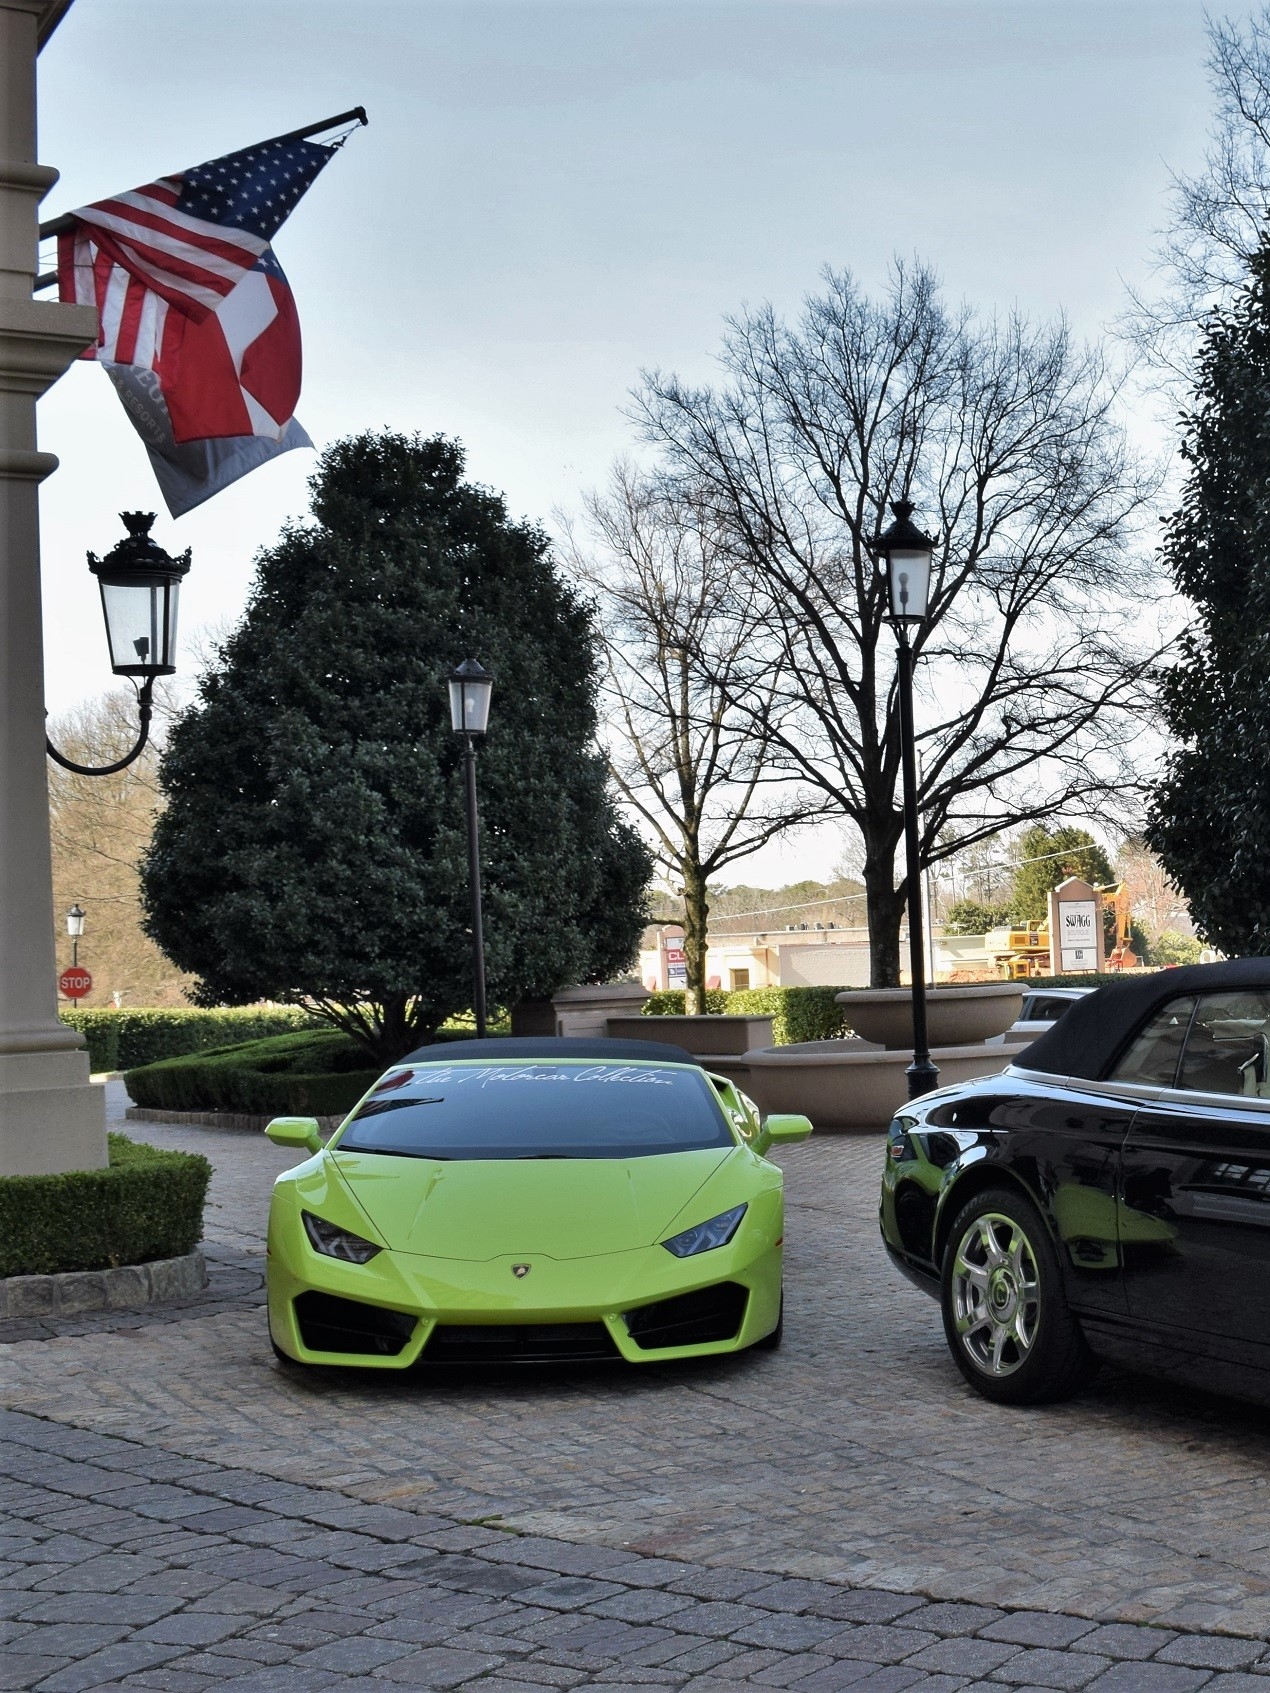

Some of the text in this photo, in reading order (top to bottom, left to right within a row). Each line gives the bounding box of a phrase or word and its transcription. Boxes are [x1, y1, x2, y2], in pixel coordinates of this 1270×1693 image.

[125, 389, 166, 443] RESORTS
[1065, 914, 1091, 928] SWAGG
[668, 951, 685, 961] CL
[61, 977, 91, 989] STOP
[458, 1065, 571, 1089] Motorcar
[573, 1066, 678, 1086] Collection
